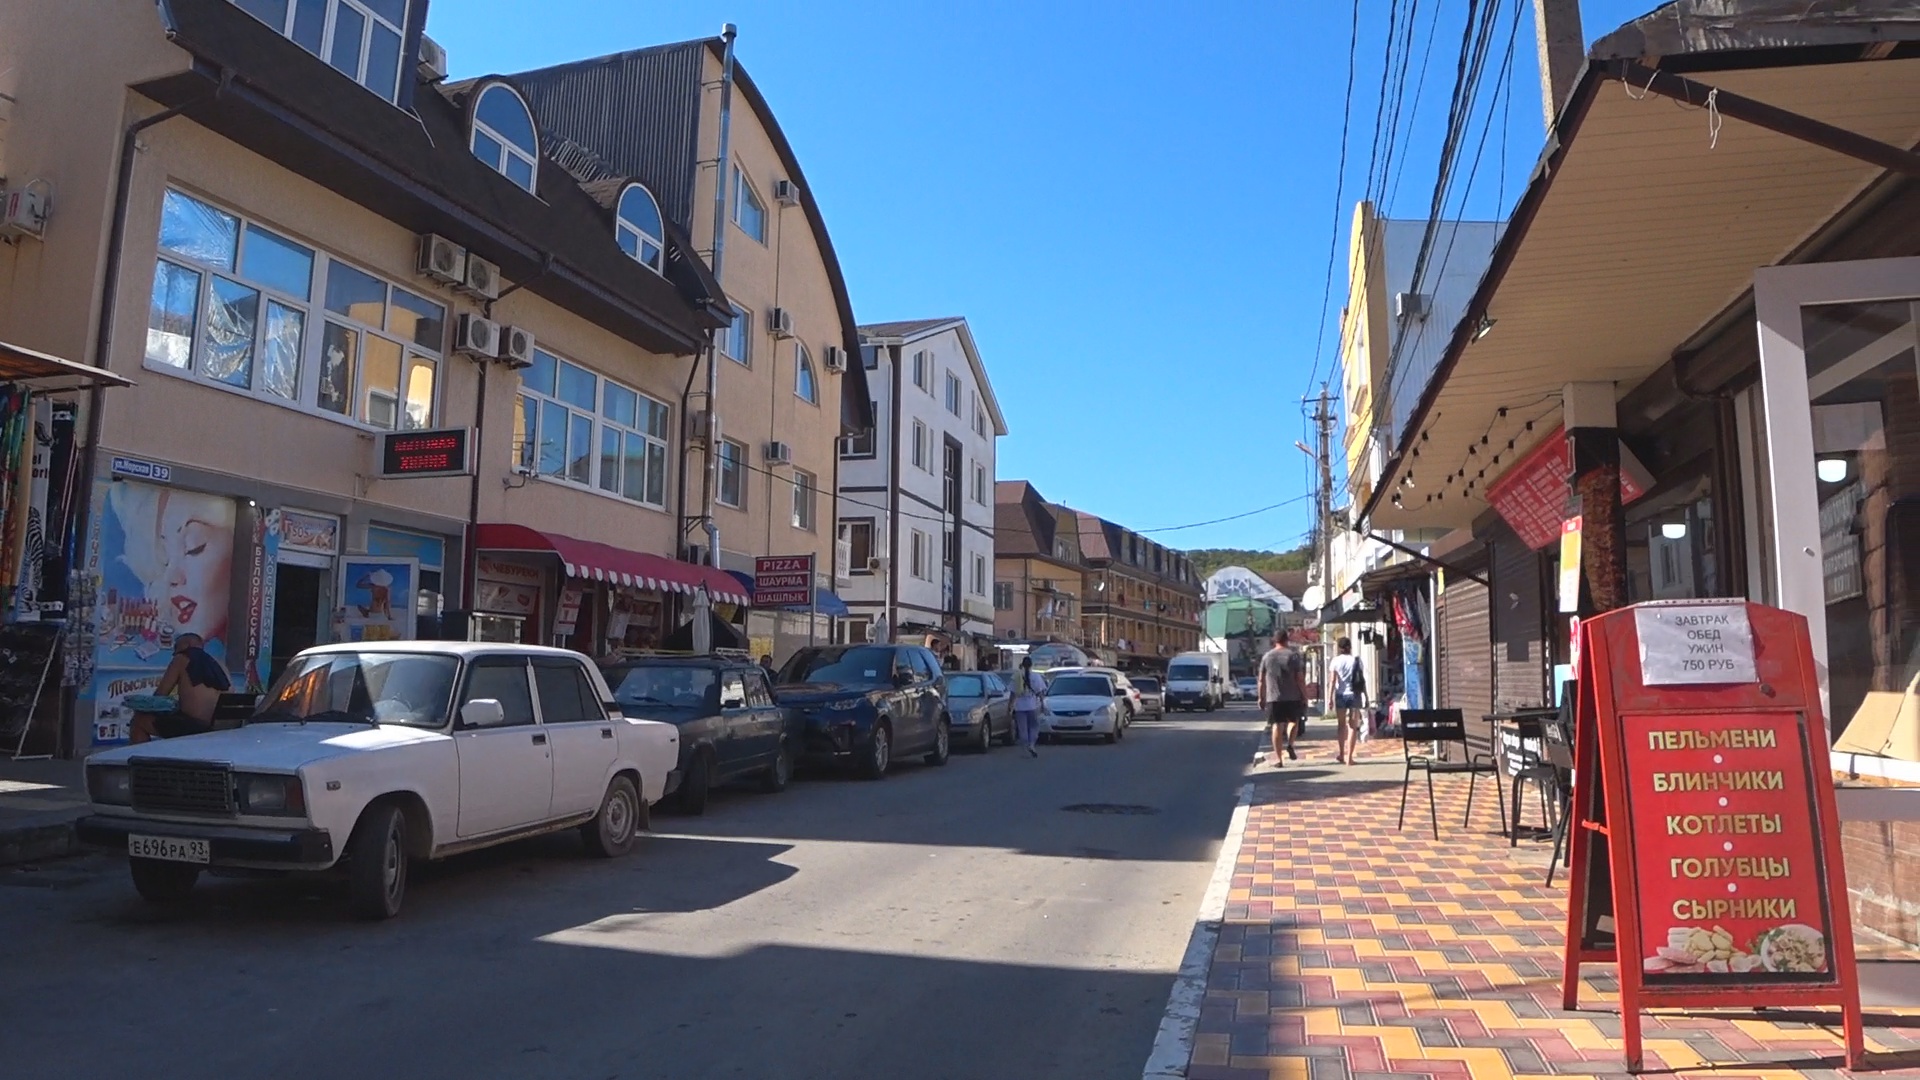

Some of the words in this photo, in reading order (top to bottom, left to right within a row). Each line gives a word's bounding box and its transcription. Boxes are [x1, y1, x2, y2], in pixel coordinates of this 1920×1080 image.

[153, 466, 169, 479] 39
[763, 560, 801, 571] PIZZA
[759, 576, 803, 587] ШАУРМА
[248, 546, 262, 657] БЕЛОРУССКАЯ
[756, 592, 804, 603] ШАШЛЫК
[1674, 615, 1730, 626] ЗАВТРАК
[1686, 629, 1722, 641] ОБЕД
[1687, 643, 1724, 654] УЖИН
[1682, 659, 1705, 671] 750
[1708, 659, 1735, 670] РУБ
[1648, 729, 1777, 750] ПЕЛЬМЕНИ
[1652, 770, 1784, 792] БЛИНЧИКИ
[1666, 813, 1782, 835] КОТЛЕТЫ
[1670, 857, 1790, 880] ГОЛУБЦЫ
[1672, 898, 1797, 920] СЫРНИКИ
